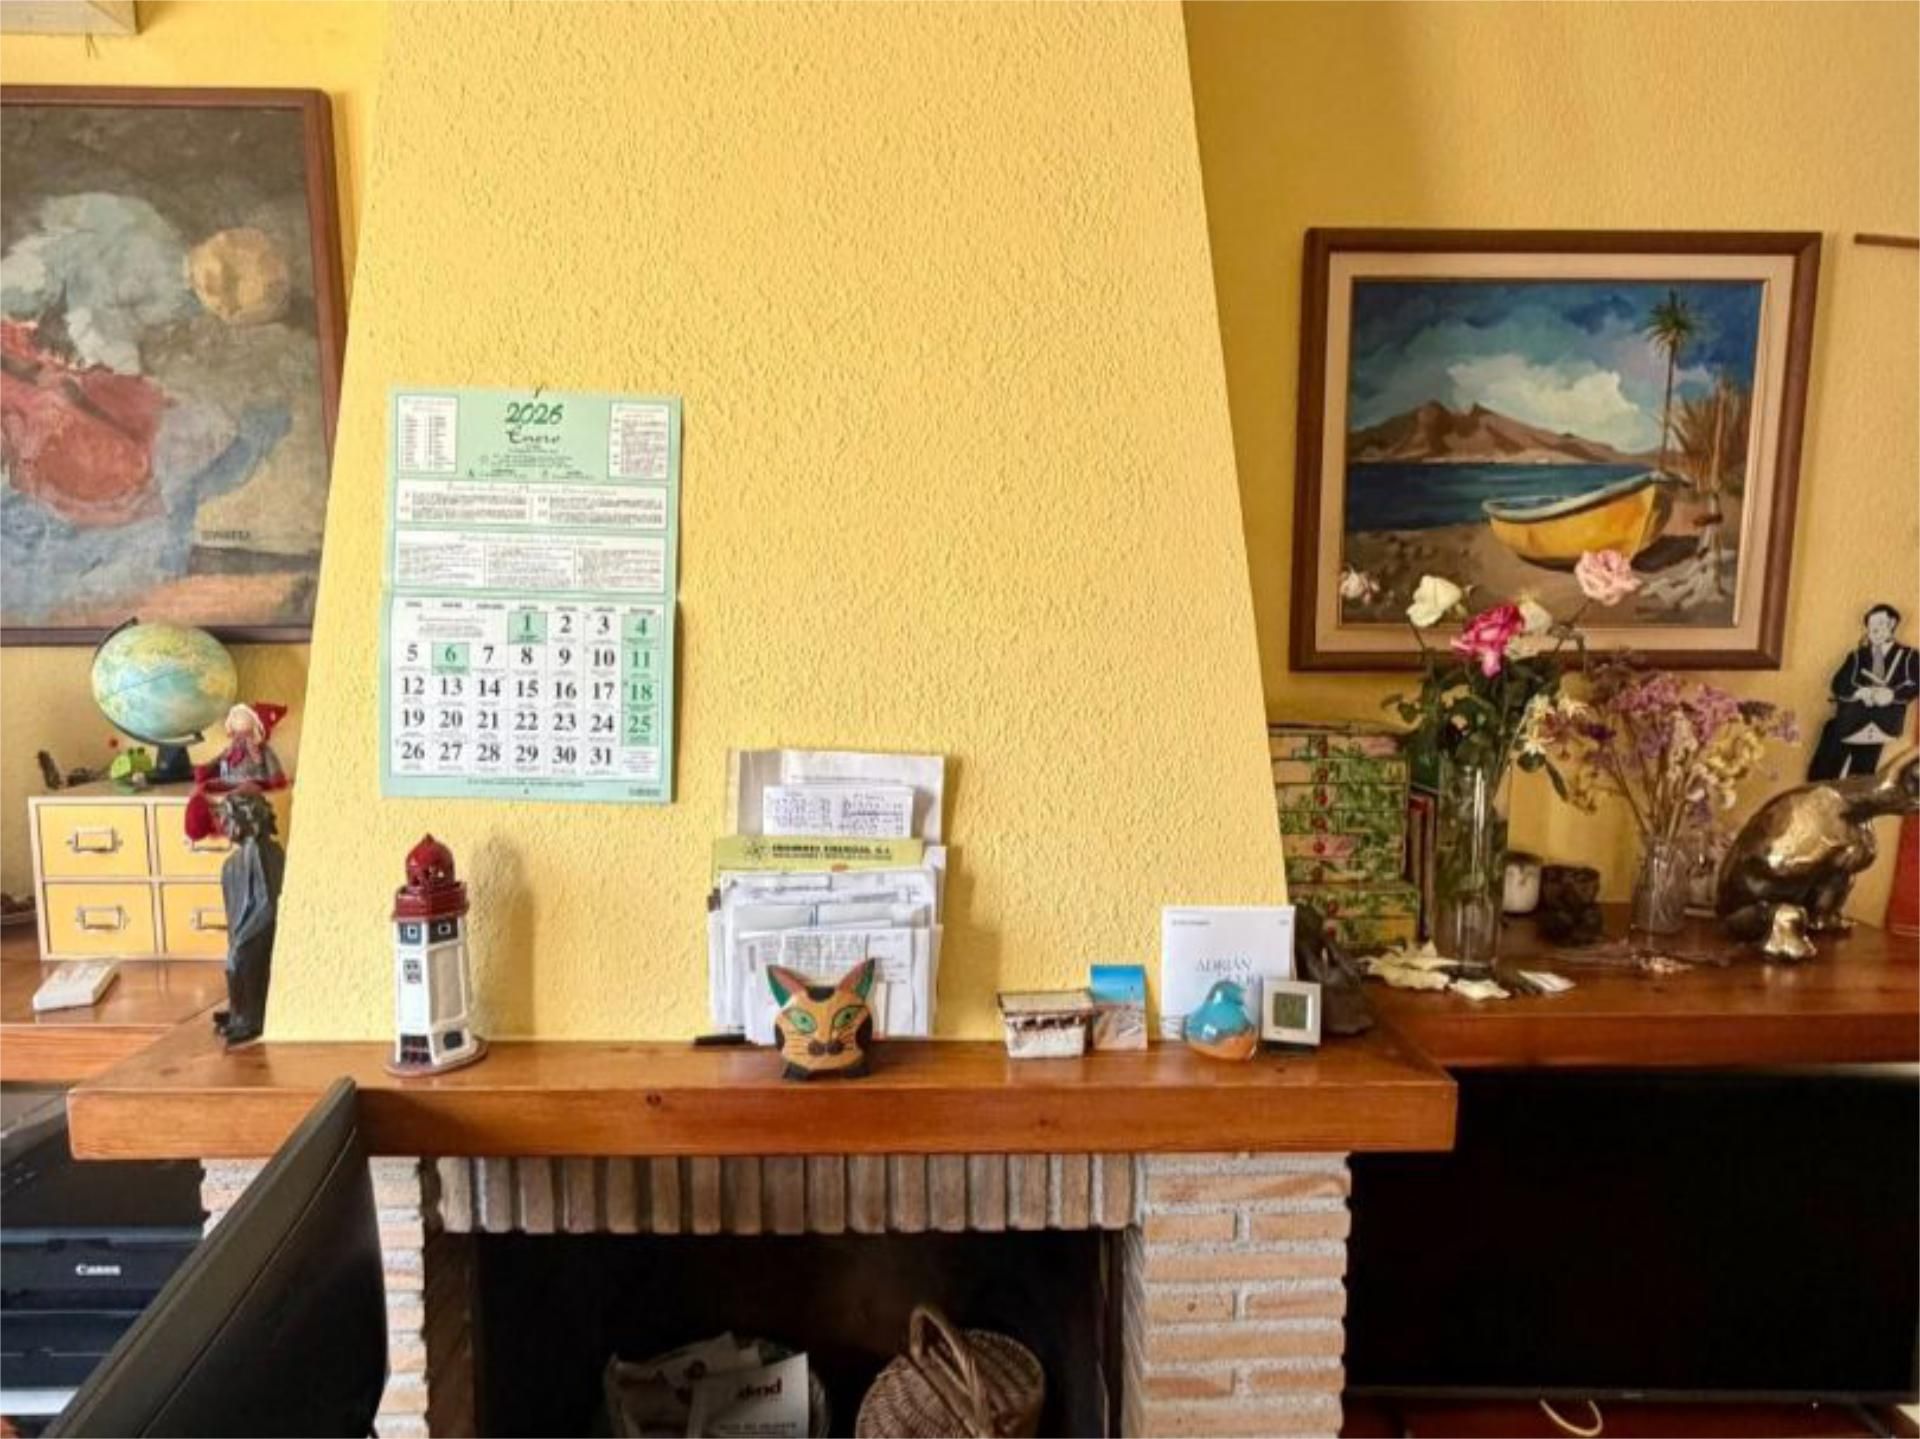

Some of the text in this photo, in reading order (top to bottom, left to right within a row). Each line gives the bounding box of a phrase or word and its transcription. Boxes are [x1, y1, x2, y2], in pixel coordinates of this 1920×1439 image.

[504, 402, 563, 426] 2026
[506, 426, 561, 446] Enero
[521, 614, 647, 635] 1 2 3 4
[407, 643, 650, 669] 5 6 7 8 9 10 11
[402, 676, 653, 702] 12 13 14 15 16 17 18
[402, 709, 651, 734] 19 20 21 22 23 24 25
[401, 741, 425, 760] 26
[439, 742, 463, 761] 27
[477, 744, 501, 762] 28
[516, 744, 539, 763] 29
[554, 746, 577, 764] 30
[592, 747, 612, 766] 31
[75, 1263, 122, 1276] Canon
